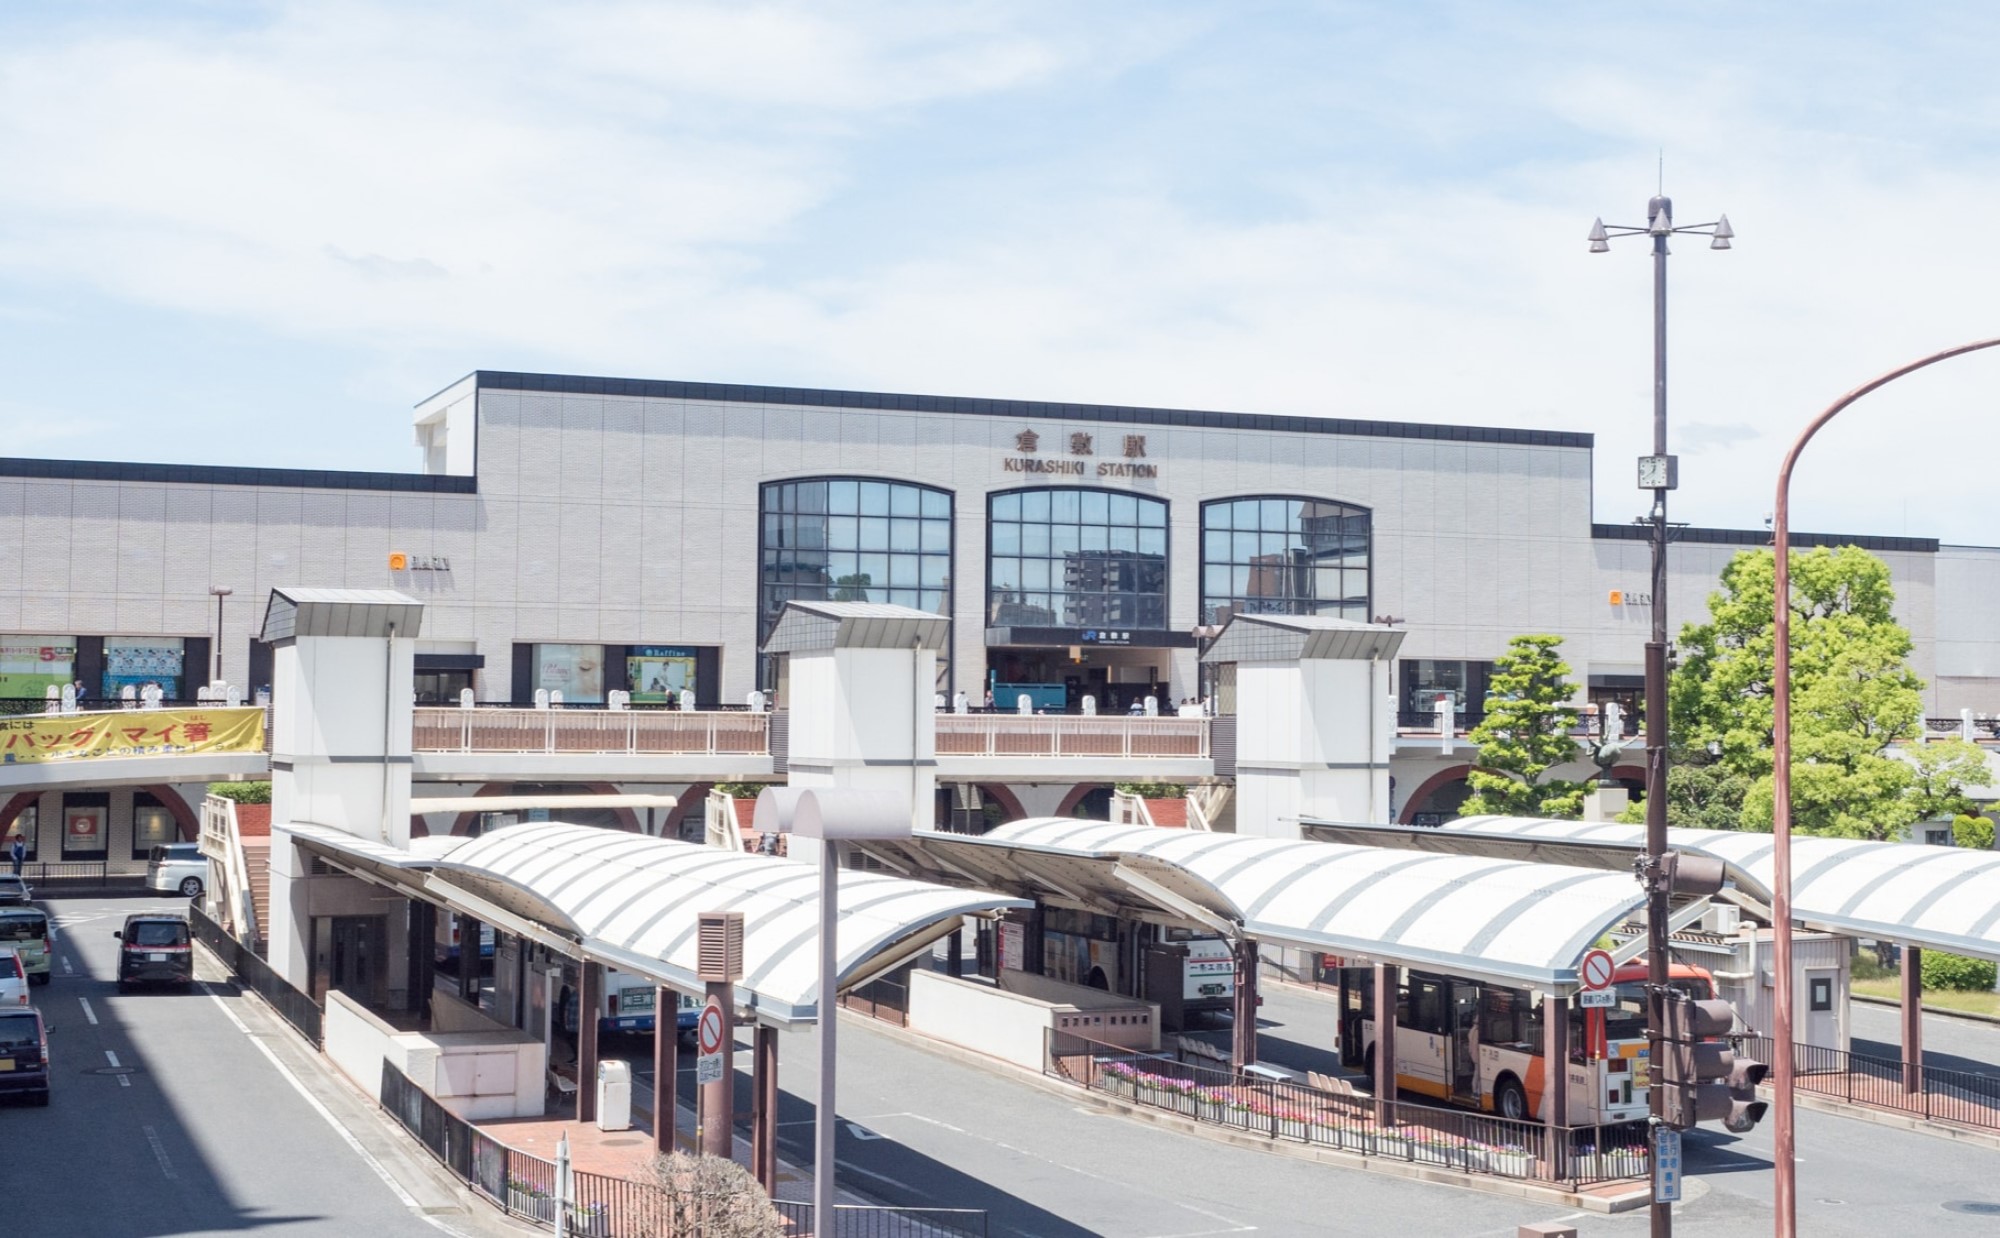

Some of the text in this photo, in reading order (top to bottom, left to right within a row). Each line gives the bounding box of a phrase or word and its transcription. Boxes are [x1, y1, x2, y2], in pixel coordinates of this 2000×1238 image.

[1016, 428, 1146, 457] 倉敷駅
[1004, 458, 1158, 478] KURASHIKI STATION
[1082, 630, 1096, 640] JR
